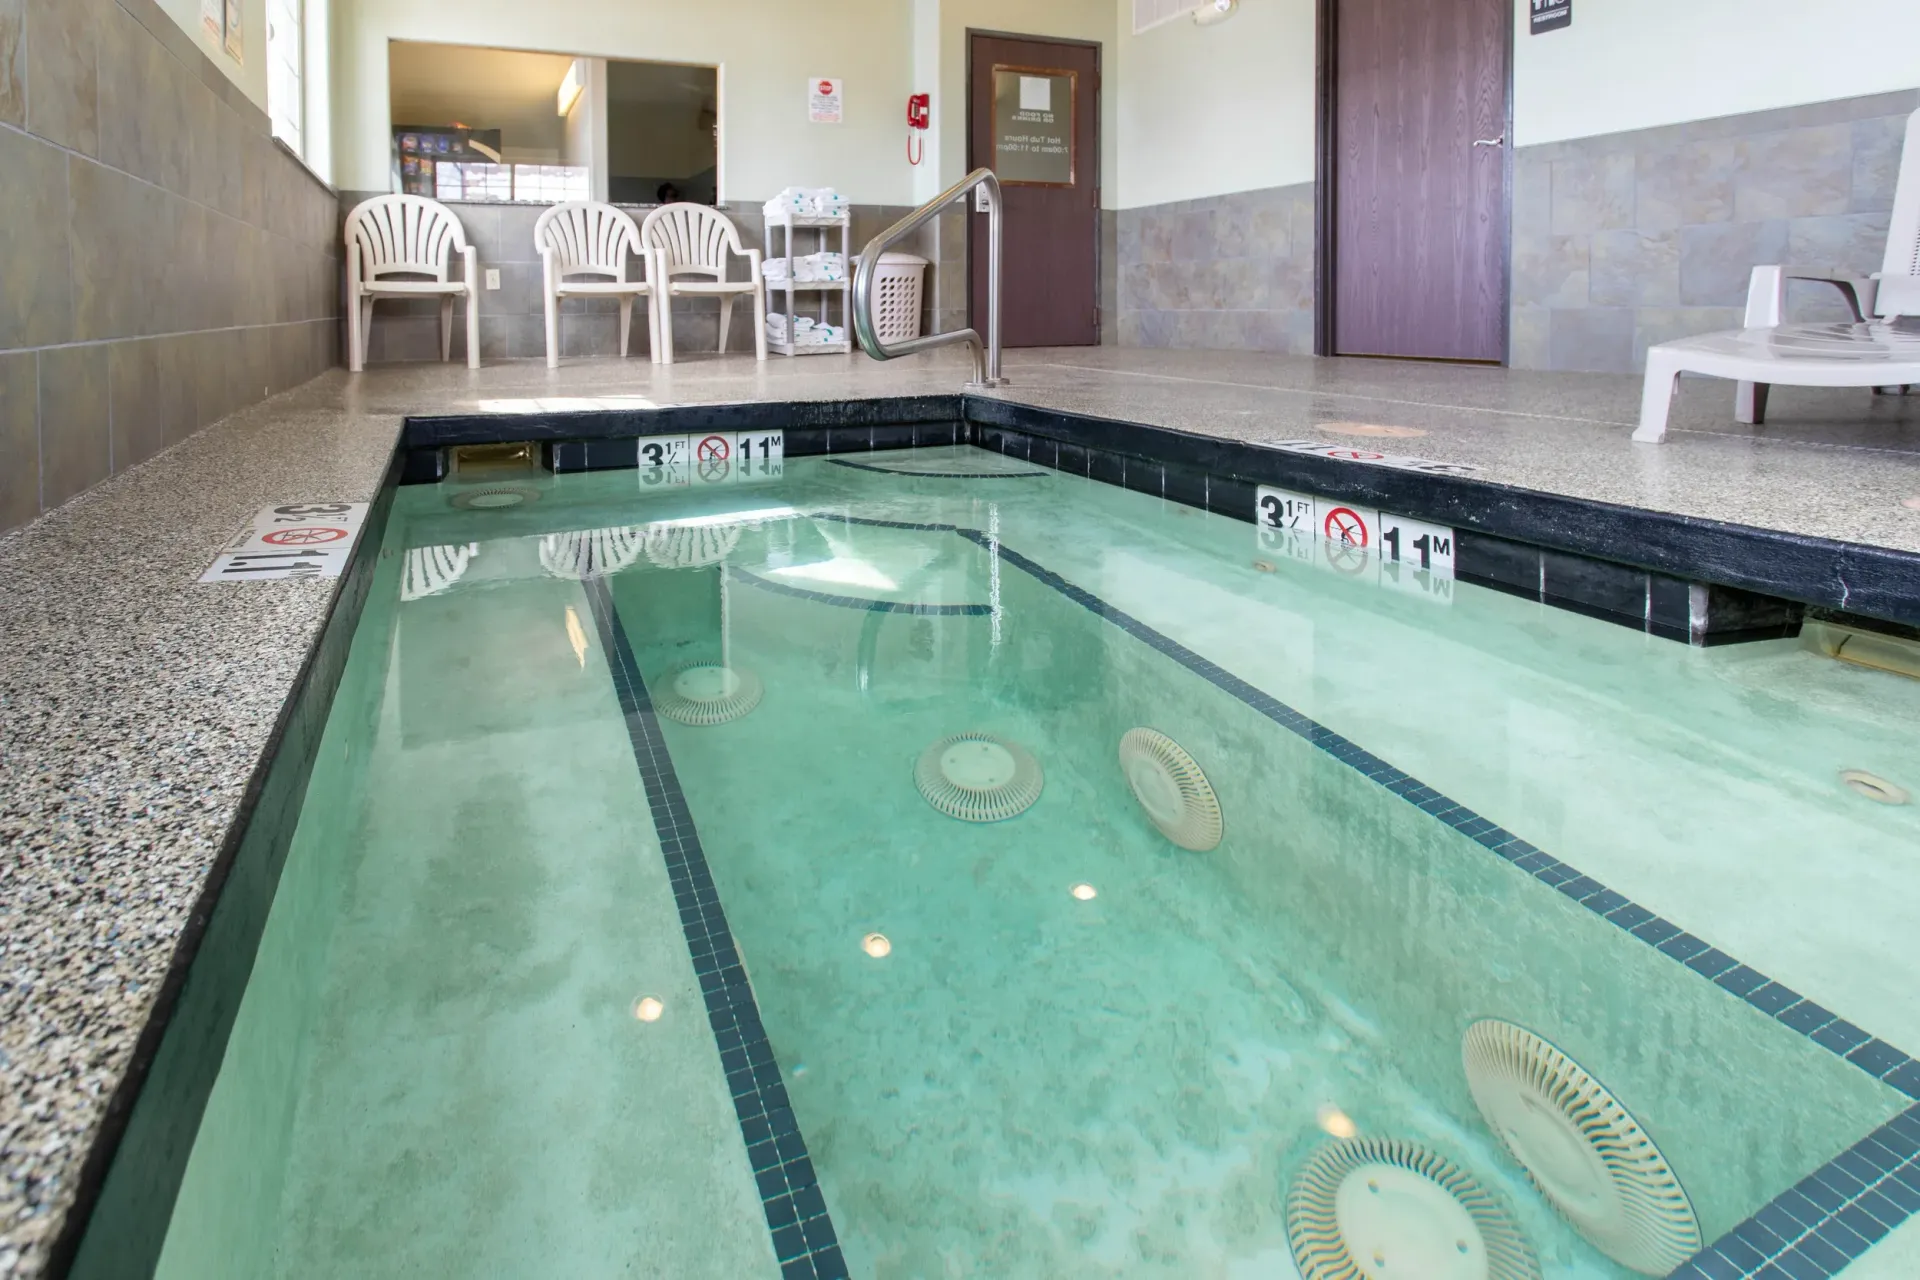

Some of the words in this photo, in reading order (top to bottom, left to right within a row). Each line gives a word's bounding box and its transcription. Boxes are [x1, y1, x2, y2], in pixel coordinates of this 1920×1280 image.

[1533, 10, 1567, 23] RESTROOM
[771, 435, 782, 447] M
[1297, 501, 1311, 515] FT
[1433, 535, 1451, 556] M
